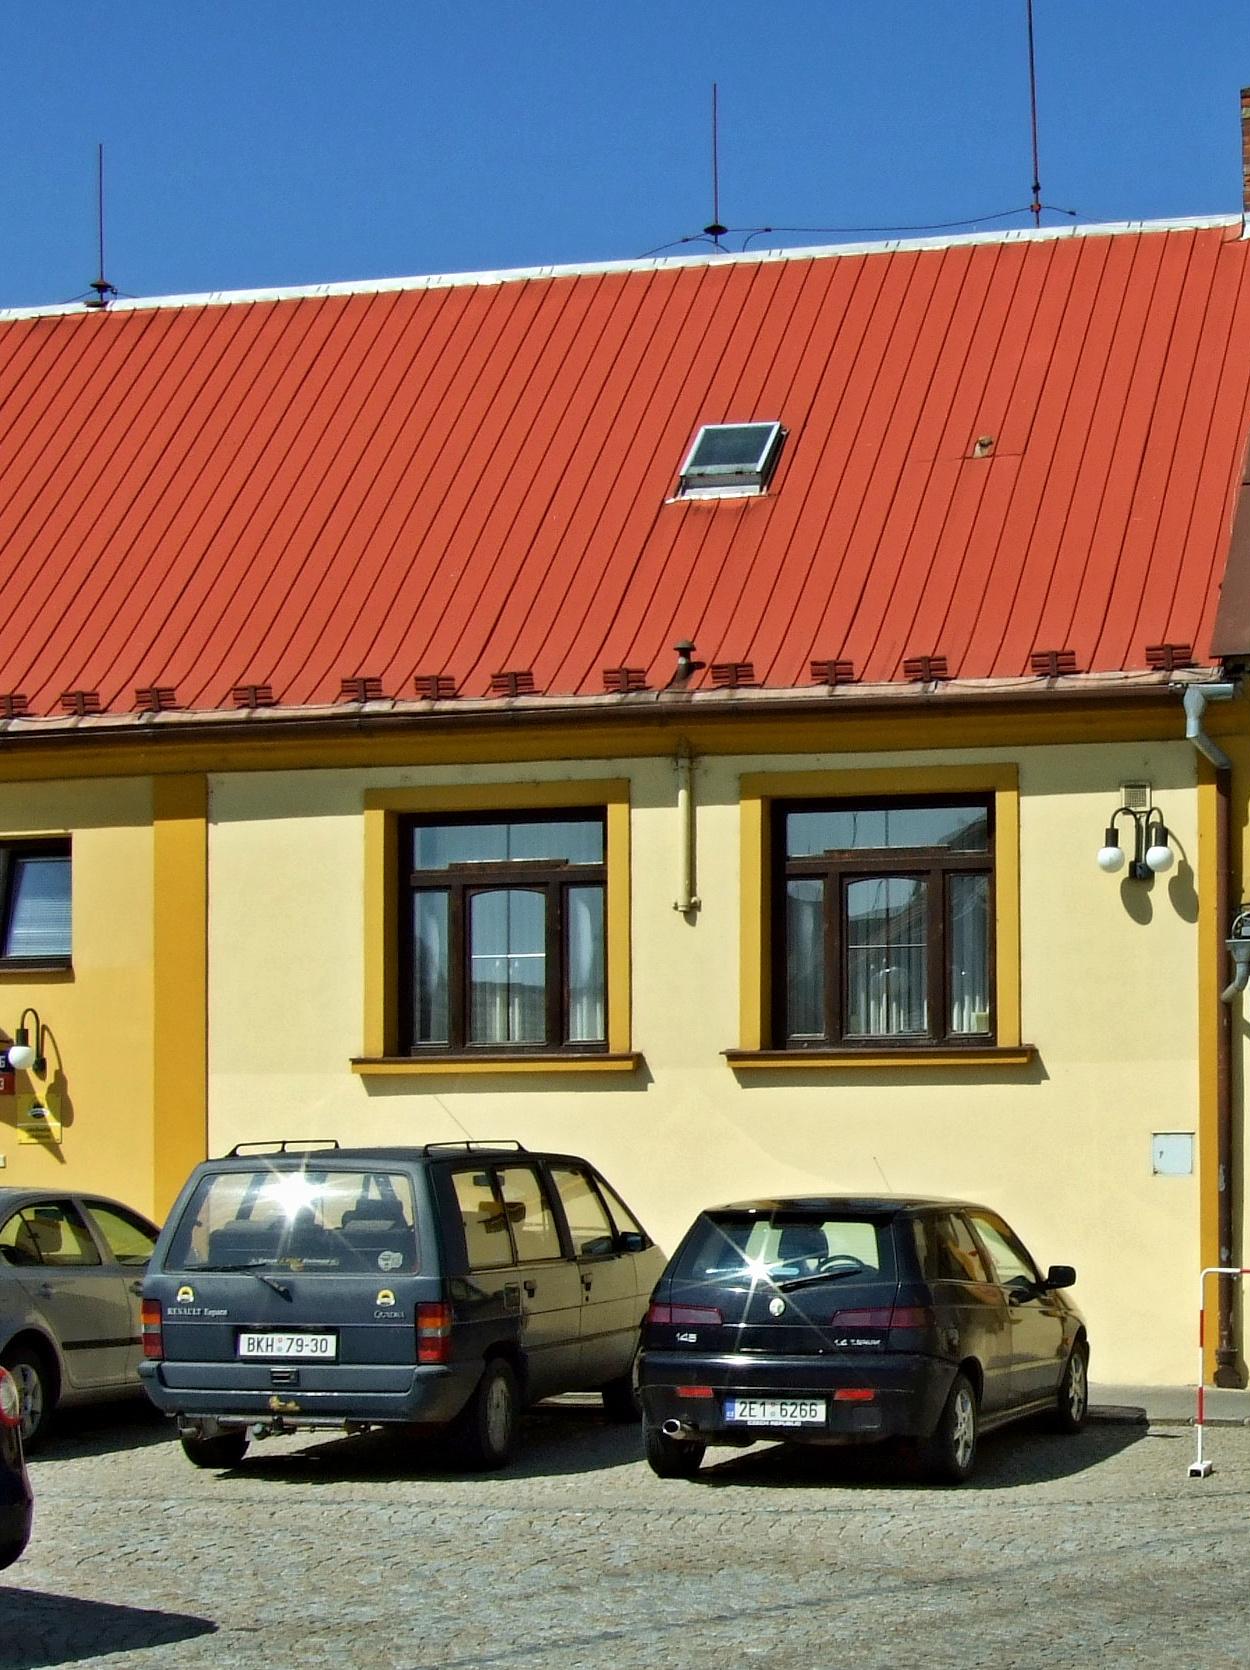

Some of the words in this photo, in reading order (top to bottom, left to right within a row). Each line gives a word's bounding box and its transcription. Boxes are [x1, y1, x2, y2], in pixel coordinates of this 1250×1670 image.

[167, 1307, 201, 1315] RENAULT
[247, 1337, 274, 1353] BKH
[286, 1337, 328, 1353] 79-30
[739, 1401, 766, 1418] 2E1
[780, 1402, 818, 1418] 6266
